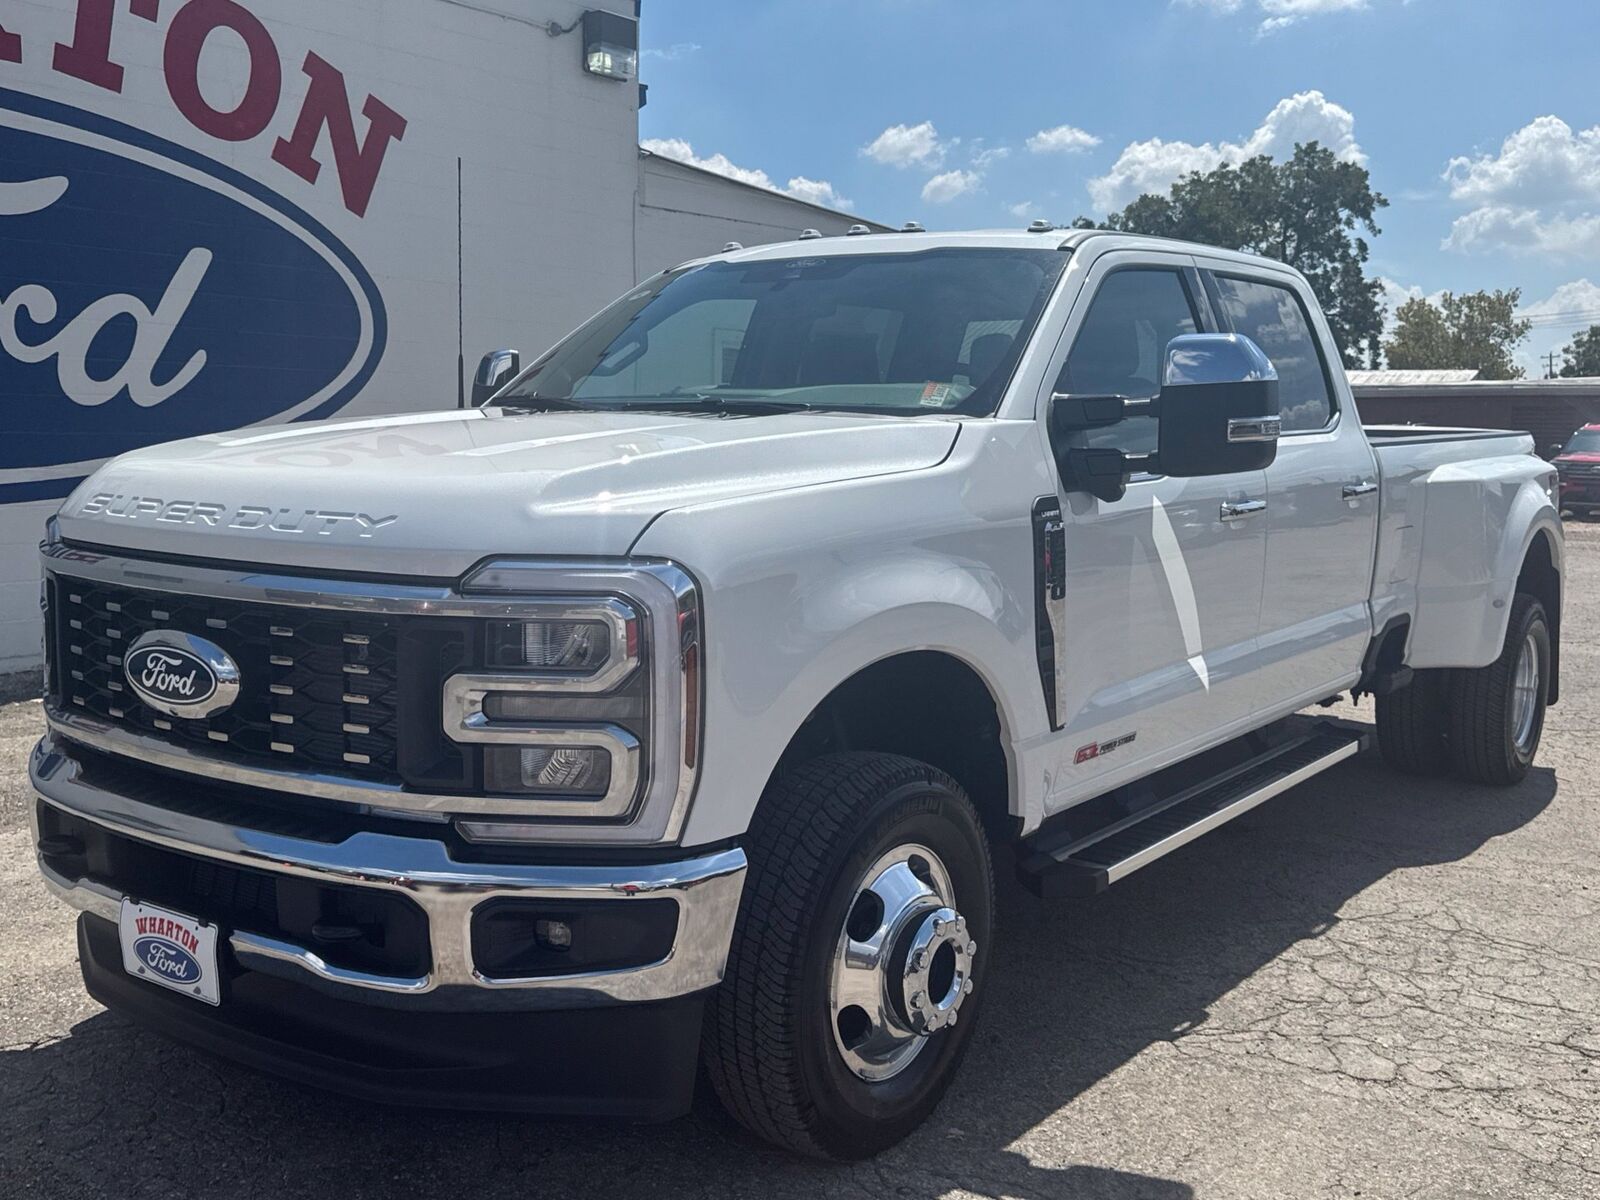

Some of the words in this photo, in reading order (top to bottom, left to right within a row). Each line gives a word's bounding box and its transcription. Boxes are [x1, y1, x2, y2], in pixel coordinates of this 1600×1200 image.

[0, 0, 408, 219] TON
[82, 493, 227, 526] SUPER
[228, 505, 399, 538] DUTY
[142, 653, 197, 696] Ford
[135, 916, 199, 955] WHARTON
[147, 942, 188, 978] Ford
